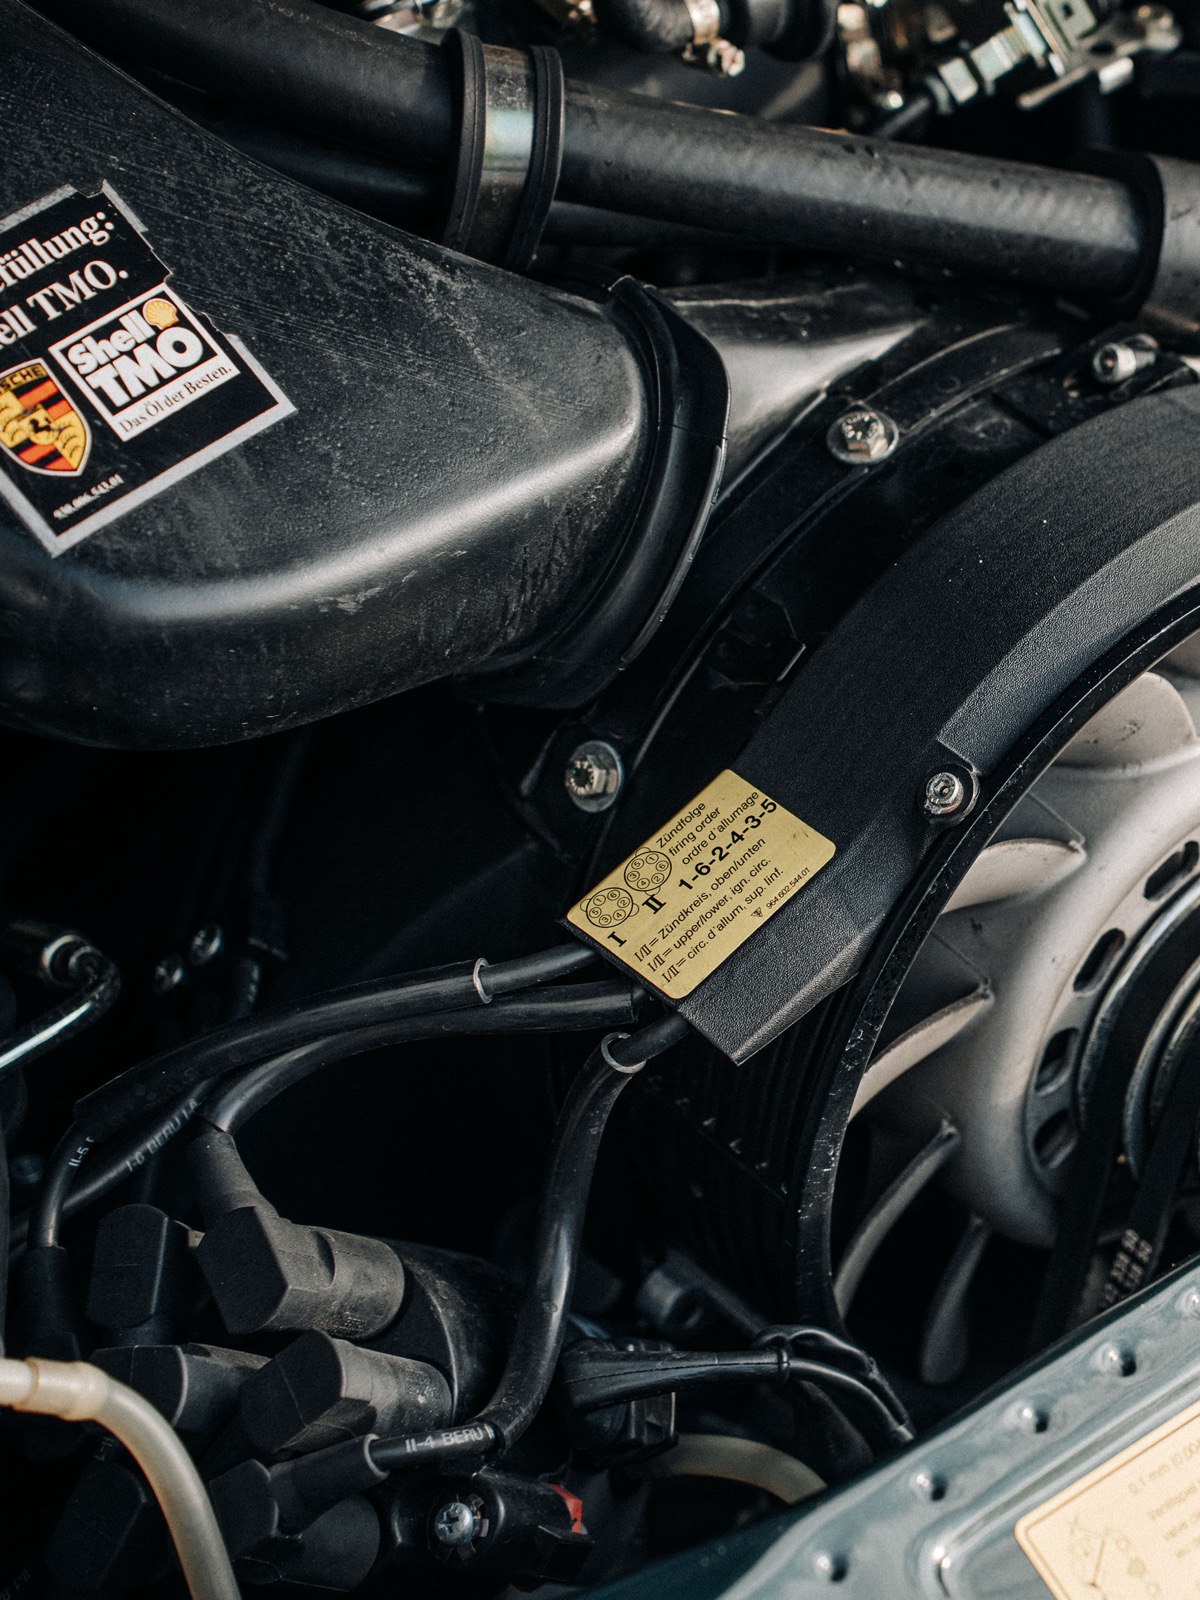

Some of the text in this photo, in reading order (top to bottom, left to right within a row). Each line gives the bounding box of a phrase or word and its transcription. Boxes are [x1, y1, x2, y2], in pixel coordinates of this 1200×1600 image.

[0, 211, 115, 292] füllung:
[0, 258, 129, 348] ell TMO.
[68, 310, 155, 375] Shell
[85, 327, 203, 406] TMO
[0, 366, 44, 393] SCHE
[120, 365, 232, 434] Das Öl der Besten.
[656, 802, 706, 848] Zündfolge
[668, 806, 721, 857] firing order
[679, 799, 777, 890] 1-6-2-4-3-5
[682, 791, 759, 865] ordre d'allumage
[642, 894, 667, 914] II
[658, 891, 712, 940] Zündkreis,
[711, 838, 766, 891] oben/unten
[674, 894, 733, 949] upper/lower,
[731, 880, 750, 898] ign.
[750, 860, 771, 877] circ.
[766, 867, 810, 909] 964.602.544.01
[607, 931, 627, 947] I
[687, 940, 709, 960] circ.
[708, 903, 747, 940] d'allum,
[745, 886, 767, 905] sup.
[441, 1426, 484, 1446] BERU
[1164, 1522, 1189, 1541] valve
